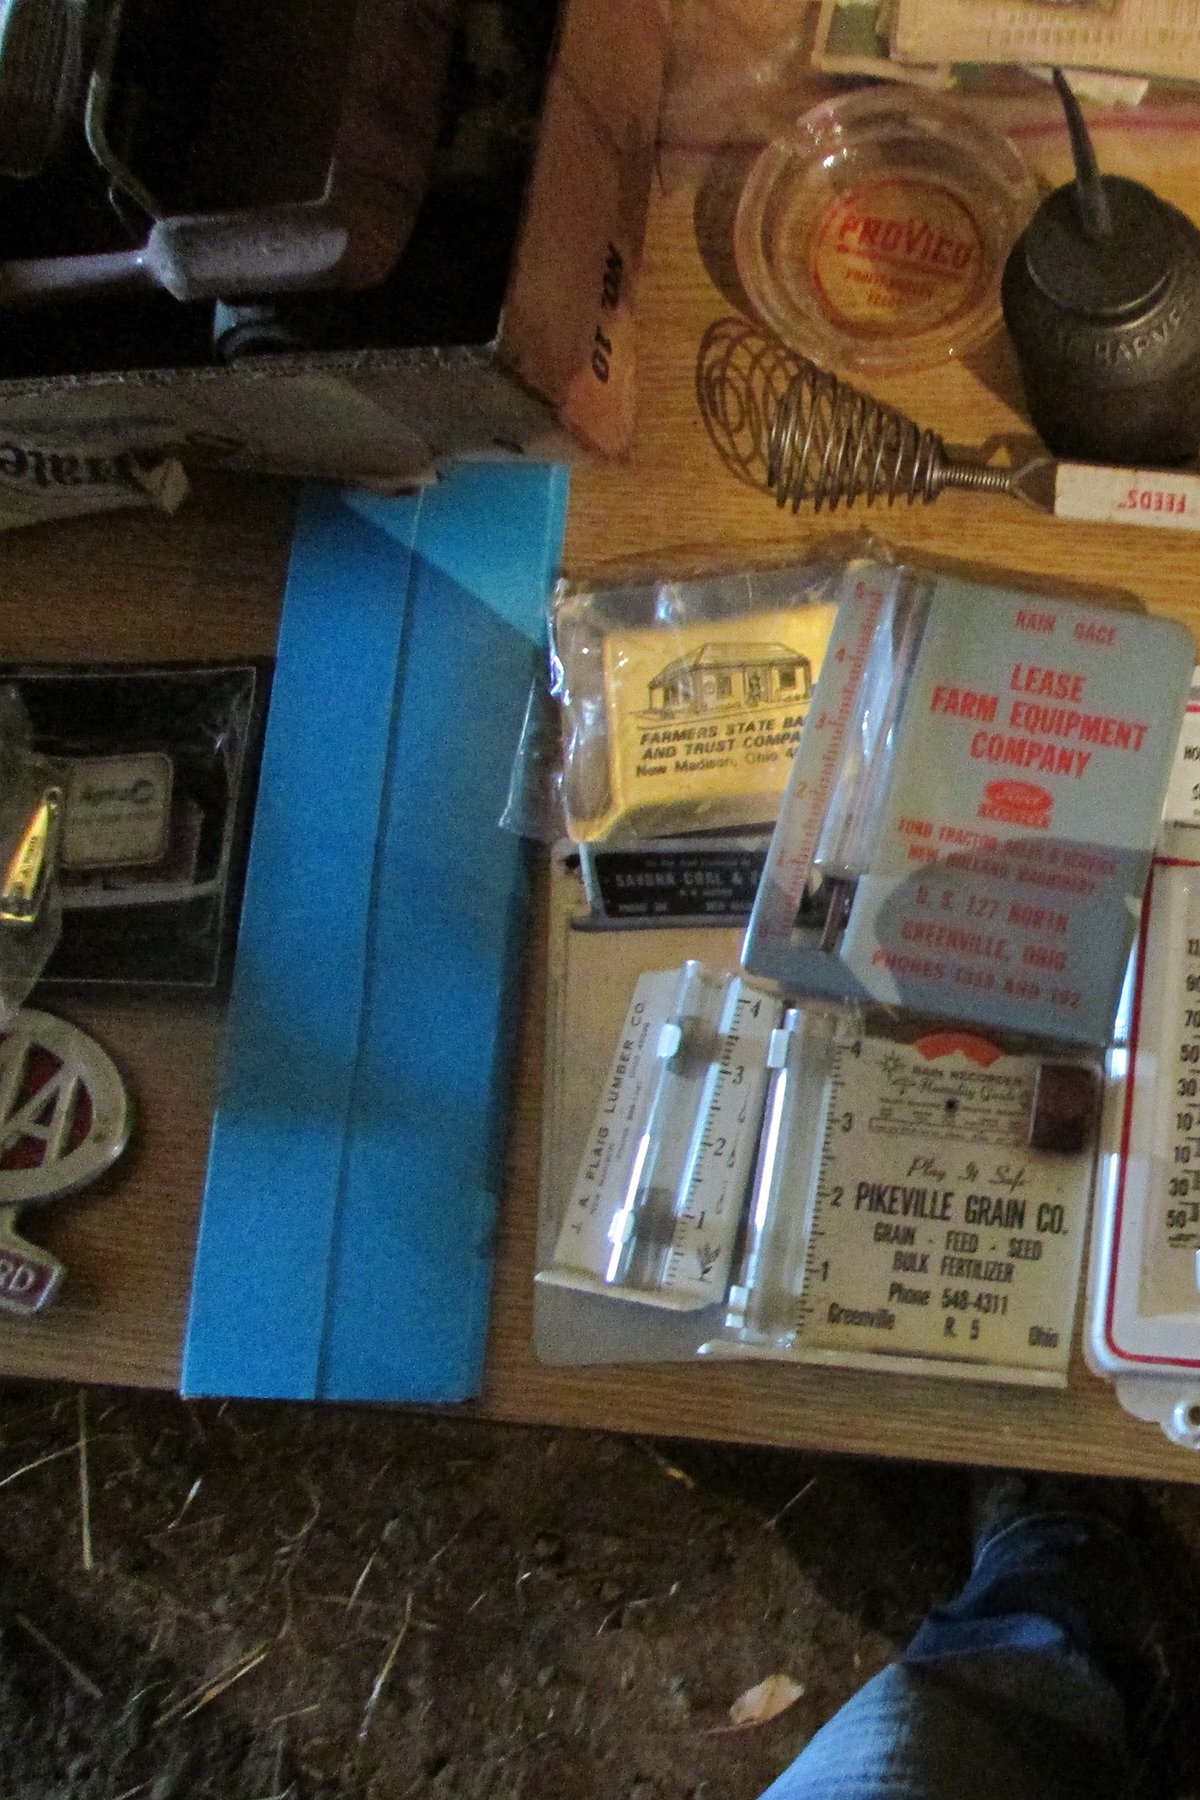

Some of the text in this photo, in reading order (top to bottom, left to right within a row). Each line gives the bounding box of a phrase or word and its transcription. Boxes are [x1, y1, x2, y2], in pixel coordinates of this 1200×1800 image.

[1014, 608, 1057, 635] RAIN
[1010, 662, 1087, 703] LEASE
[640, 715, 805, 746] FARMERS STATE BA
[930, 685, 1150, 752] FARM EQUIPMENT
[642, 730, 801, 761] AND TRUST COMPA
[970, 730, 1092, 778] COMPANY
[636, 763, 668, 778] New
[745, 751, 779, 765] Ohio
[966, 895, 998, 919] 127
[871, 950, 944, 980] PHONES
[1021, 944, 1069, 973] OHIO
[750, 999, 762, 1020] 4
[849, 1042, 862, 1061] 4
[1179, 1043, 1200, 1064] 50
[605, 1038, 635, 1115] LUMBER
[732, 1064, 745, 1085] 3
[1177, 1077, 1198, 1098] 30
[841, 1111, 853, 1133] 3
[1176, 1111, 1194, 1132] 10
[712, 1137, 727, 1157] 2
[1174, 1144, 1191, 1164] 10
[906, 1155, 947, 1182] Play
[1168, 1177, 1190, 1197] 30
[830, 1192, 844, 1209] 2
[854, 1180, 1070, 1236] PIKEVILLE GRAIN CO.
[1165, 1208, 1187, 1229] 50
[873, 1220, 1043, 1261] GRAIN FEED SEED
[821, 1259, 831, 1282] 1
[892, 1250, 1016, 1284] BULK FERTILIZER
[887, 1280, 931, 1306] Phone
[827, 1302, 896, 1330] Greenville
[1028, 1324, 1060, 1349] Ohio
